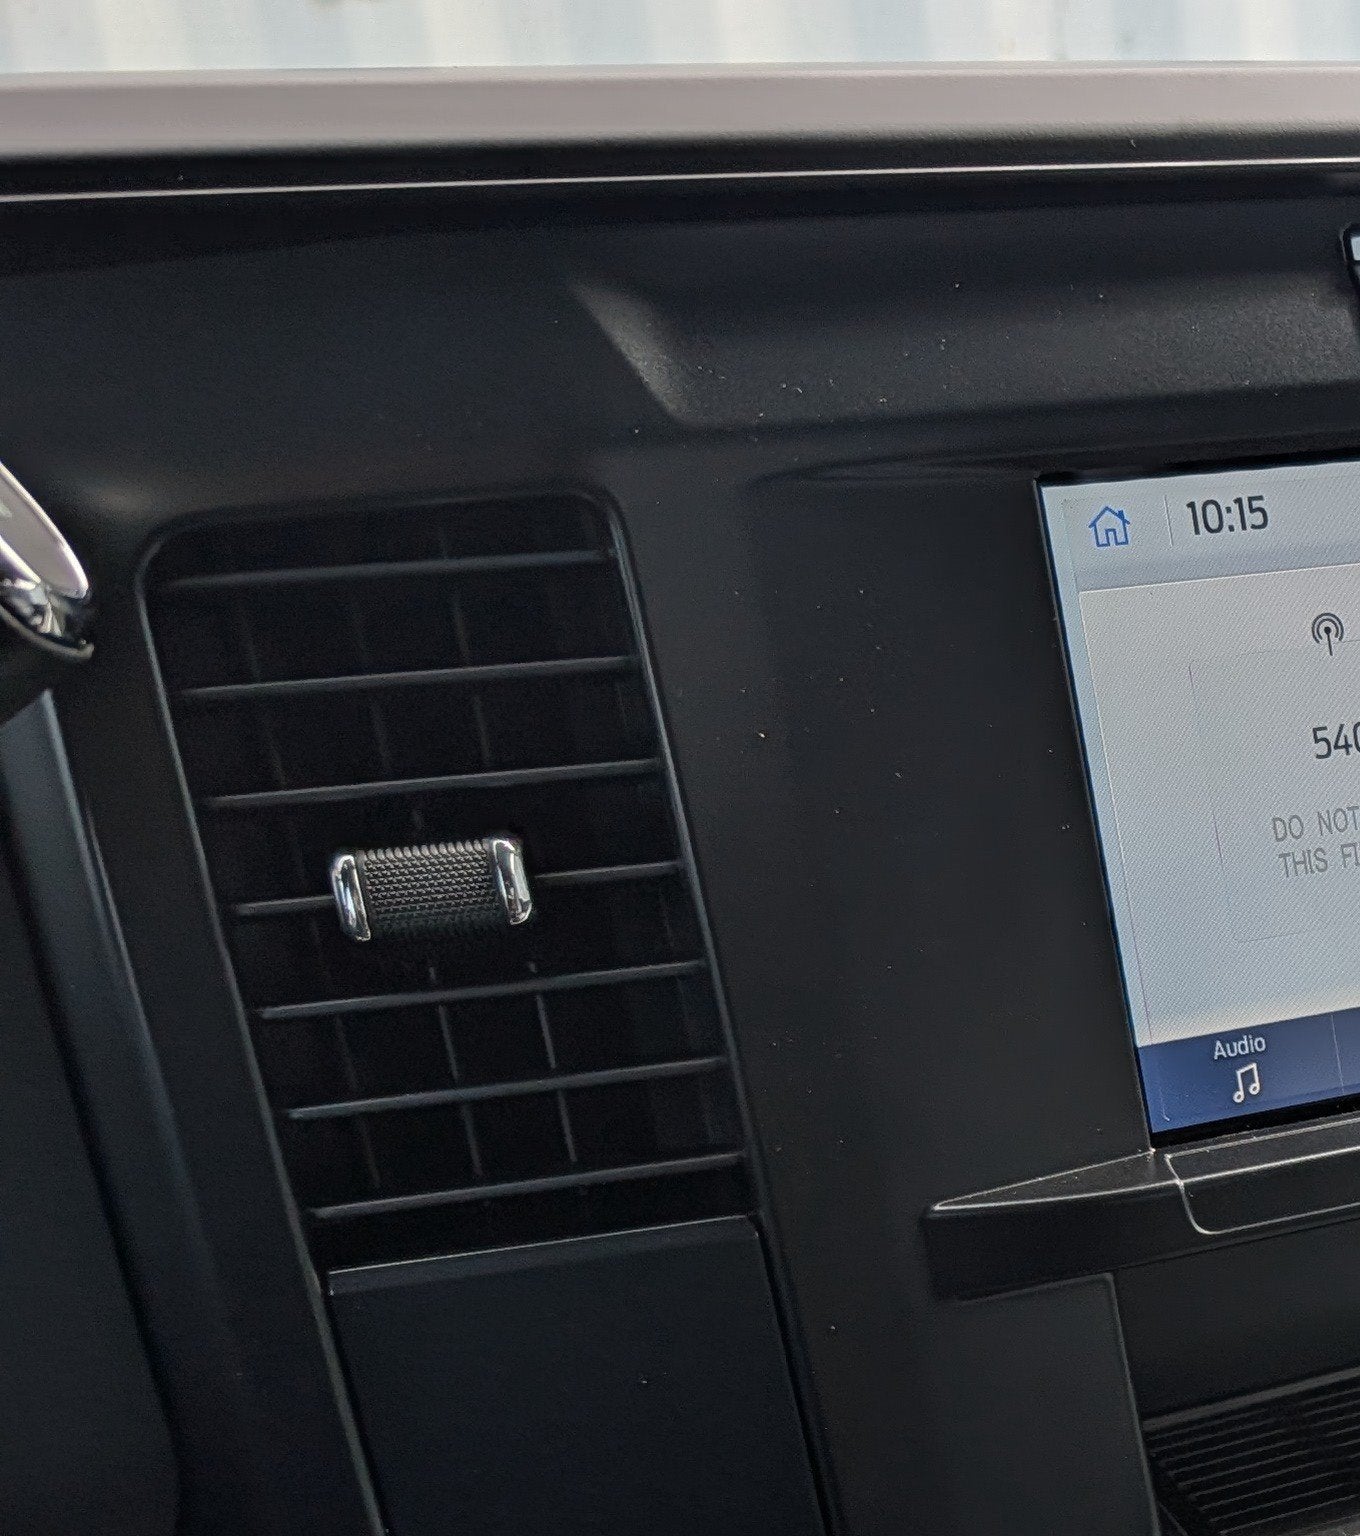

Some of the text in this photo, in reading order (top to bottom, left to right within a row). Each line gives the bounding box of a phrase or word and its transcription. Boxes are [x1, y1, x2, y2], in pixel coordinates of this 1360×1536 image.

[1186, 495, 1269, 536] 10:15
[1272, 814, 1304, 842] DO
[1317, 805, 1360, 836] NOT
[1278, 847, 1329, 878] THIS
[1213, 1034, 1267, 1061] Audio
